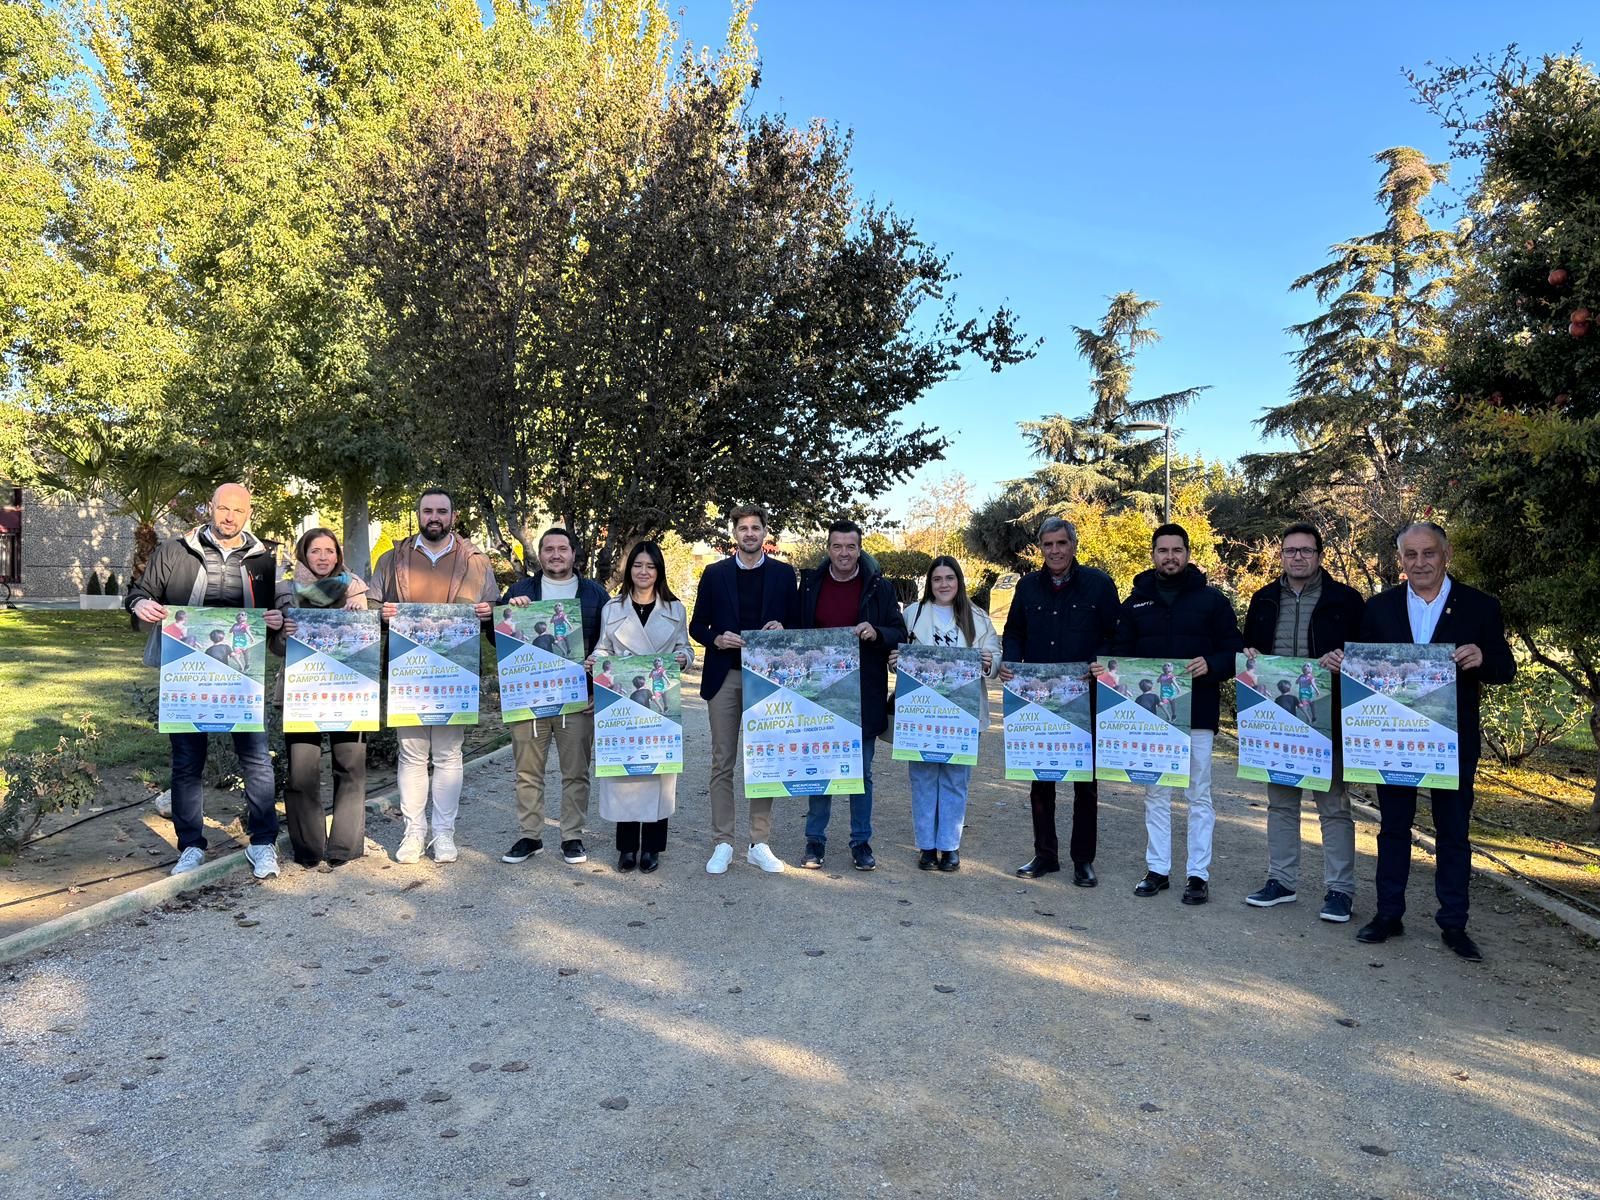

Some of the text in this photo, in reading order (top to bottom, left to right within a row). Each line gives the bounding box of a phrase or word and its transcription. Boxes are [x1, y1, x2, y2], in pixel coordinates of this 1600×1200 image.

[406, 656, 427, 665] XXIX
[514, 652, 534, 664] XXIX
[181, 662, 206, 671] XXIX
[304, 662, 326, 672] XXIX
[392, 667, 421, 676] CAMPO
[501, 666, 530, 676] CAMPO
[164, 673, 199, 682] CAMPO
[288, 674, 319, 683] CAMPO
[911, 695, 930, 704] XXIX
[611, 707, 631, 717] XXIX
[765, 701, 792, 716] XXIX
[898, 705, 925, 714] CAMPO
[1362, 705, 1388, 715] XXIX
[1019, 712, 1040, 722] XXIX
[1114, 710, 1136, 720] XXIX
[1254, 710, 1276, 720] XXIX
[598, 720, 626, 728] CAMPO
[747, 719, 785, 732] CAMPO
[787, 719, 794, 728] A
[1100, 721, 1129, 730] CAMPO
[1241, 720, 1270, 730] CAMPO
[1345, 716, 1381, 727] CAMPO
[1383, 719, 1390, 727] A
[1007, 724, 1034, 732] CAMPO
